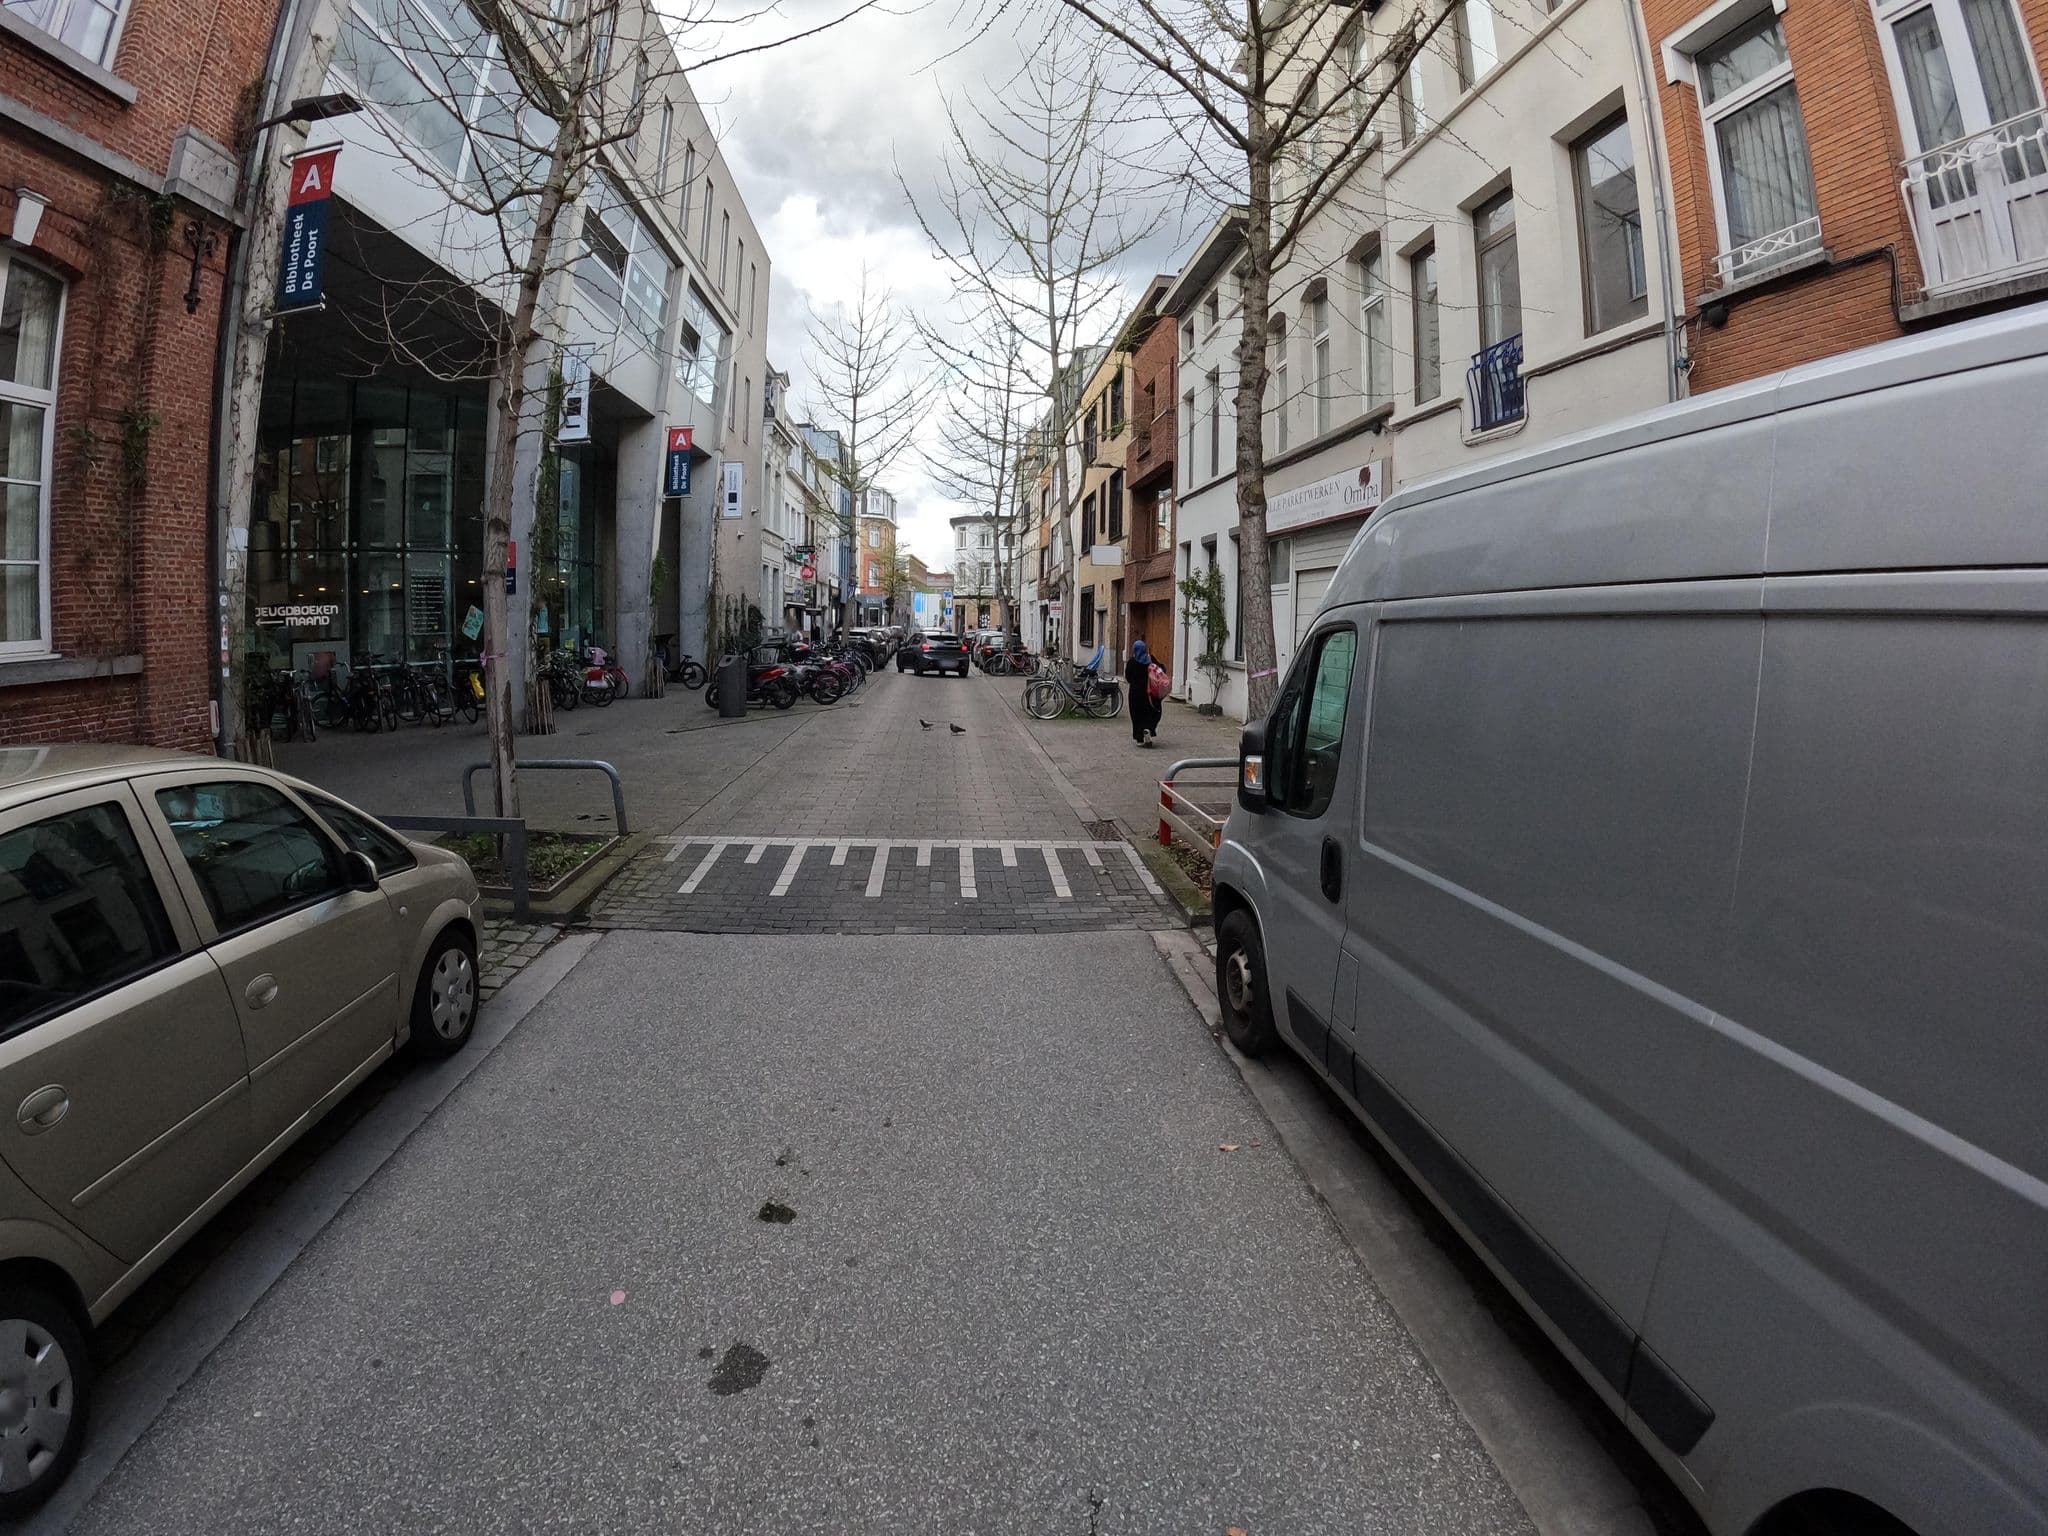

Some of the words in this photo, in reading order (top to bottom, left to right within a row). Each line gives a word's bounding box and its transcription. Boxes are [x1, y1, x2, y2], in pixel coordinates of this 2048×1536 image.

[299, 164, 321, 194] A
[285, 213, 304, 294] Bibliotheek
[304, 228, 318, 268] Poort
[302, 270, 313, 290] De
[675, 432, 686, 446] A
[285, 615, 330, 626] MAAND
